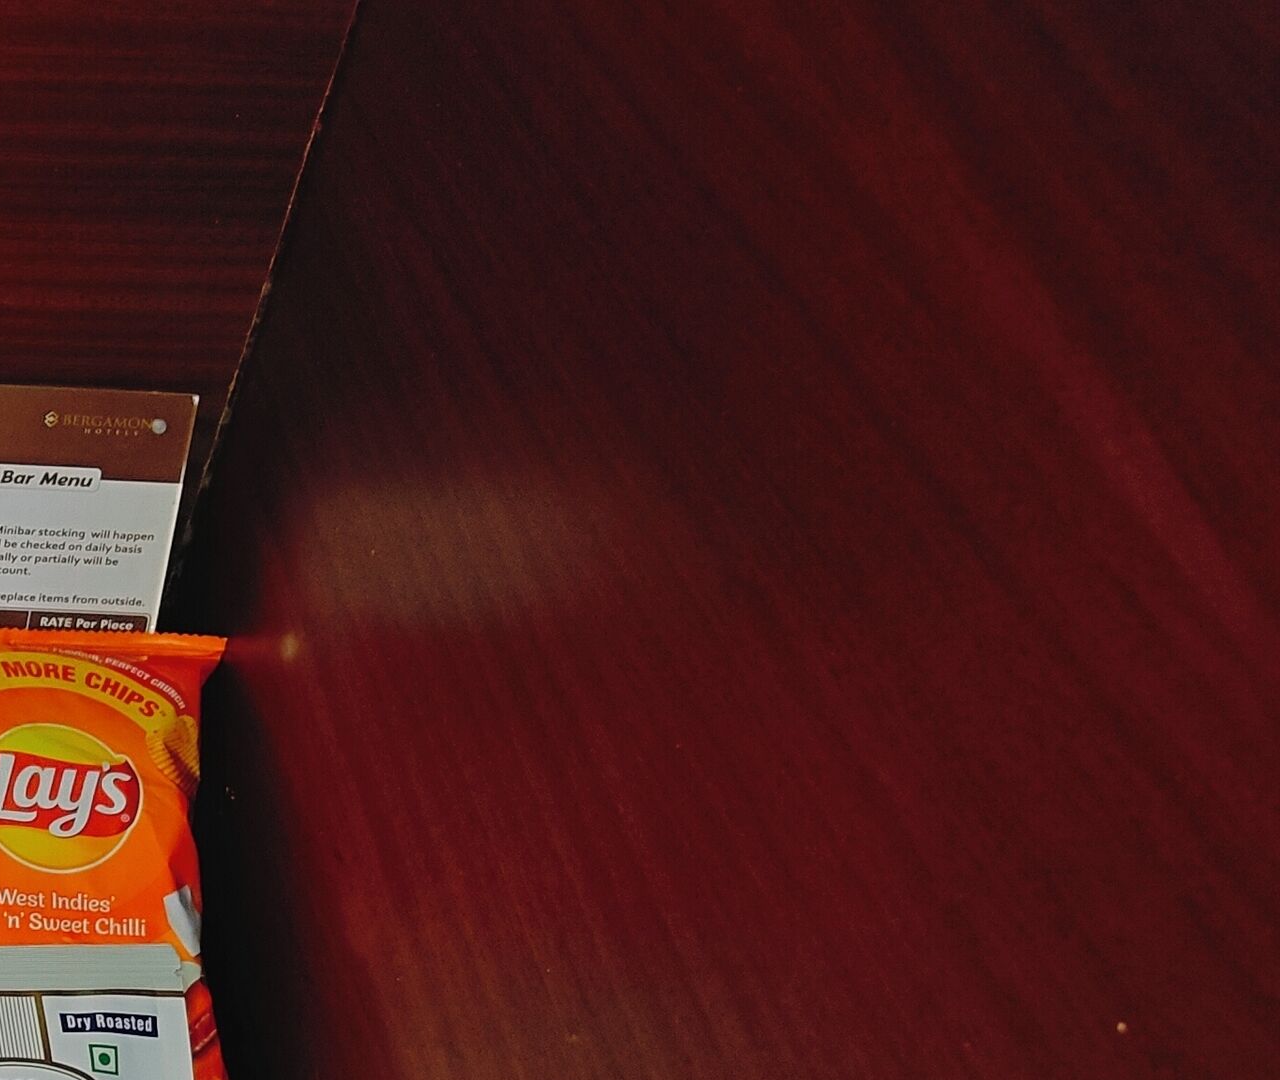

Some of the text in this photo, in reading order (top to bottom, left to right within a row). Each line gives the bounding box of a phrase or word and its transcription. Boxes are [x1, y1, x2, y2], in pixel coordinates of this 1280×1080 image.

[0, 470, 35, 485] Bar
[39, 472, 94, 488] Menu
[38, 526, 86, 540] stocking
[91, 530, 111, 539] will
[113, 530, 155, 542] happen
[20, 540, 65, 551] checked
[85, 542, 112, 554] daily
[114, 544, 143, 554] basis
[34, 554, 81, 567] partially
[83, 556, 103, 566] will
[38, 593, 69, 603] items
[71, 595, 99, 605] from
[100, 597, 145, 607] outside.
[40, 616, 72, 628] RATE
[0, 661, 77, 682] MORE
[51, 893, 116, 913] Indies'
[28, 913, 89, 935] Sweet
[94, 915, 146, 938] Chilli
[66, 1014, 153, 1033] Dry Roasted
